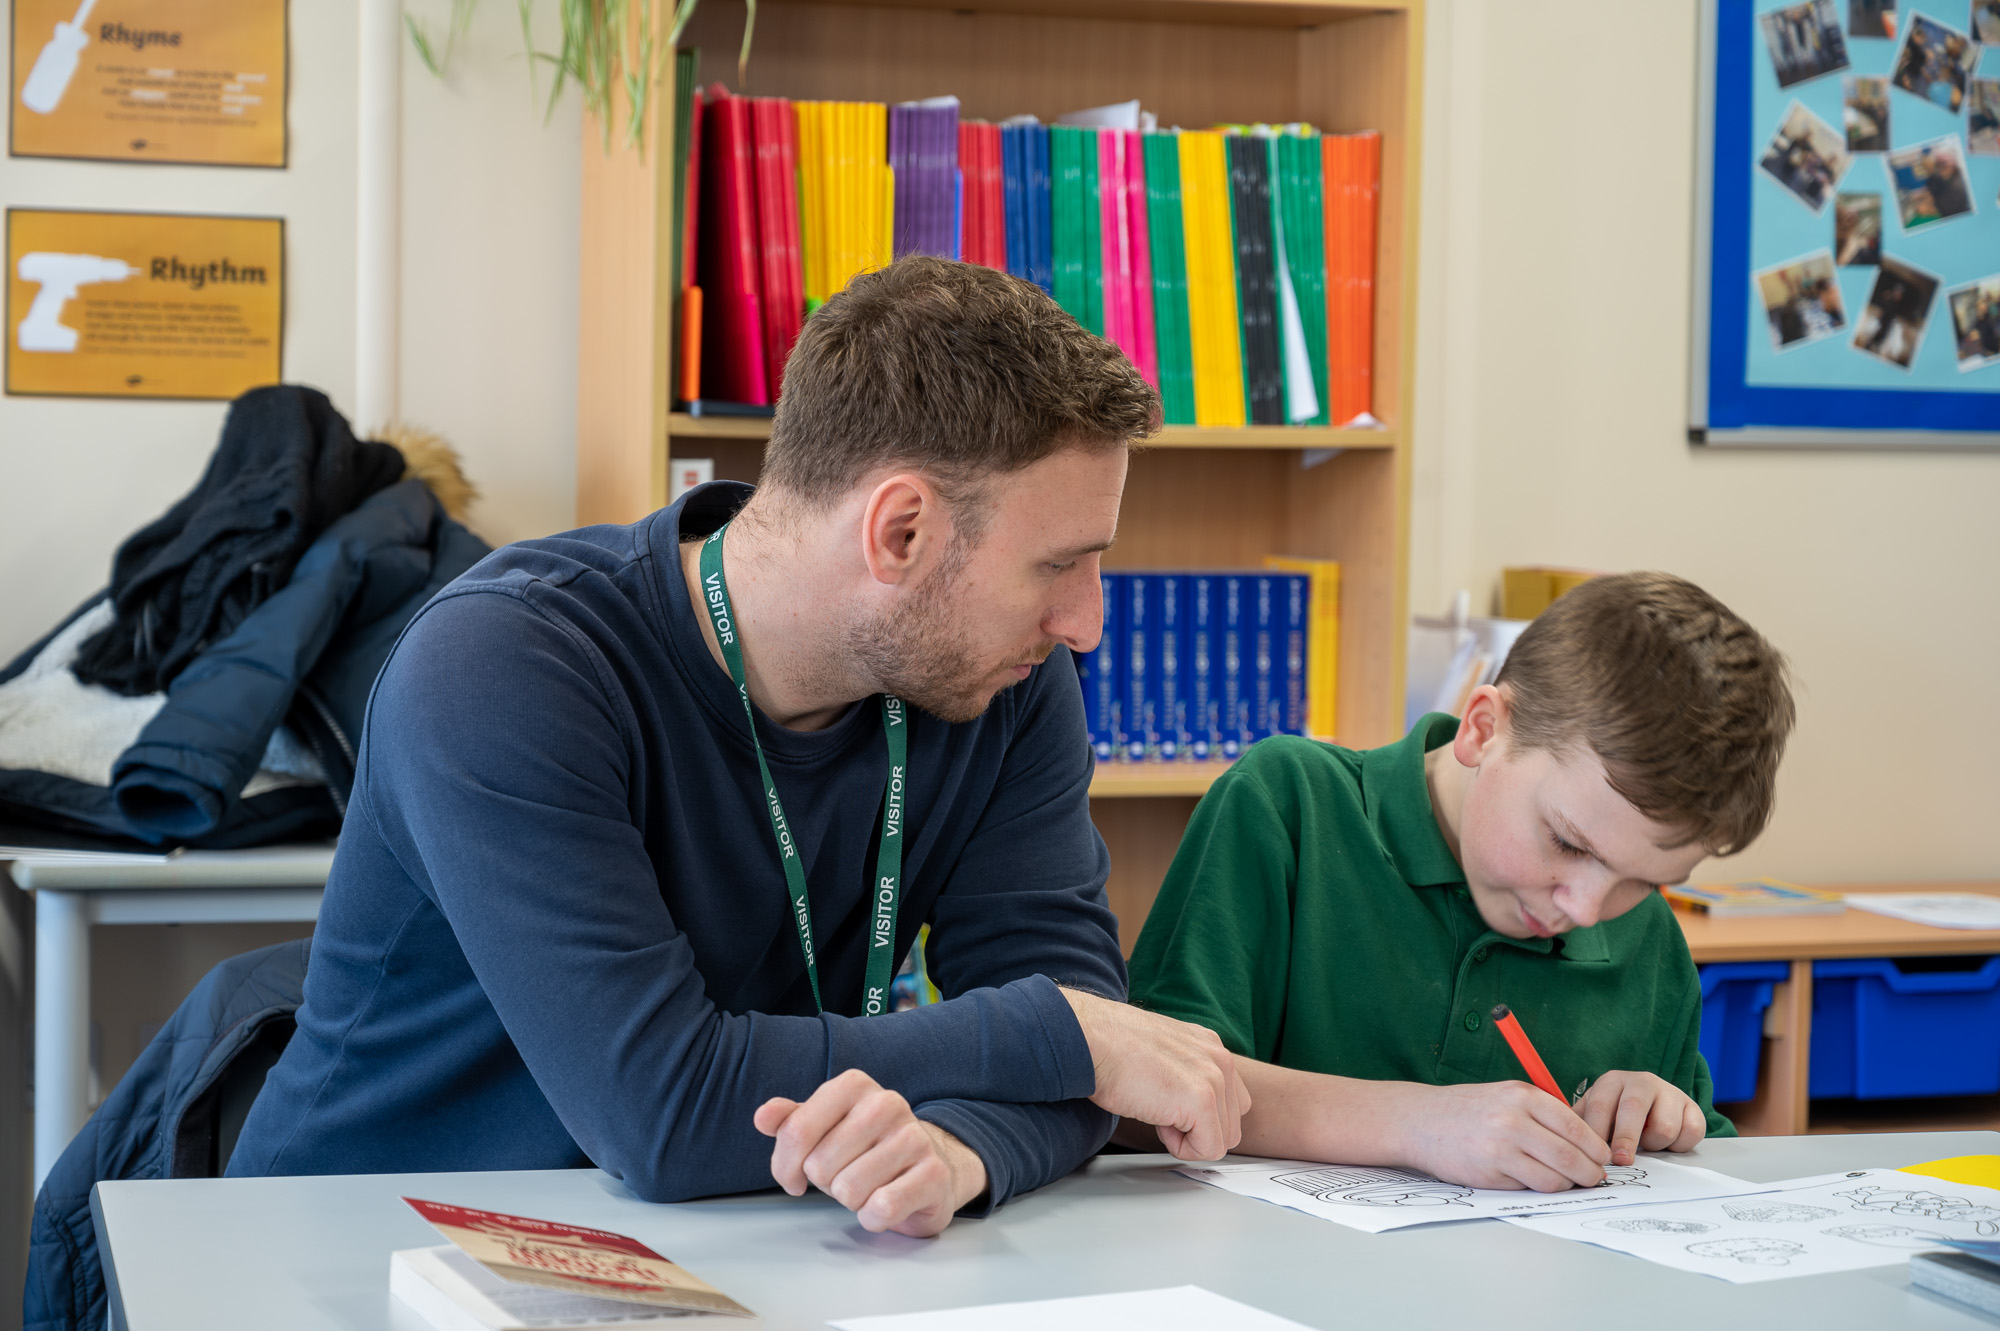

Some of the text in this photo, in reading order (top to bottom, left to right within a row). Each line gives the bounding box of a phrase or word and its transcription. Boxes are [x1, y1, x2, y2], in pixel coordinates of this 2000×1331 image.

[101, 22, 182, 51] Rhyme
[150, 255, 269, 291] Rhythm
[705, 571, 734, 646] VISITOR
[884, 694, 903, 726] VISI
[767, 787, 795, 859] VISITOR
[886, 765, 903, 837] VISITOR
[795, 894, 814, 968] VISITOR
[874, 876, 895, 948] VISITOR
